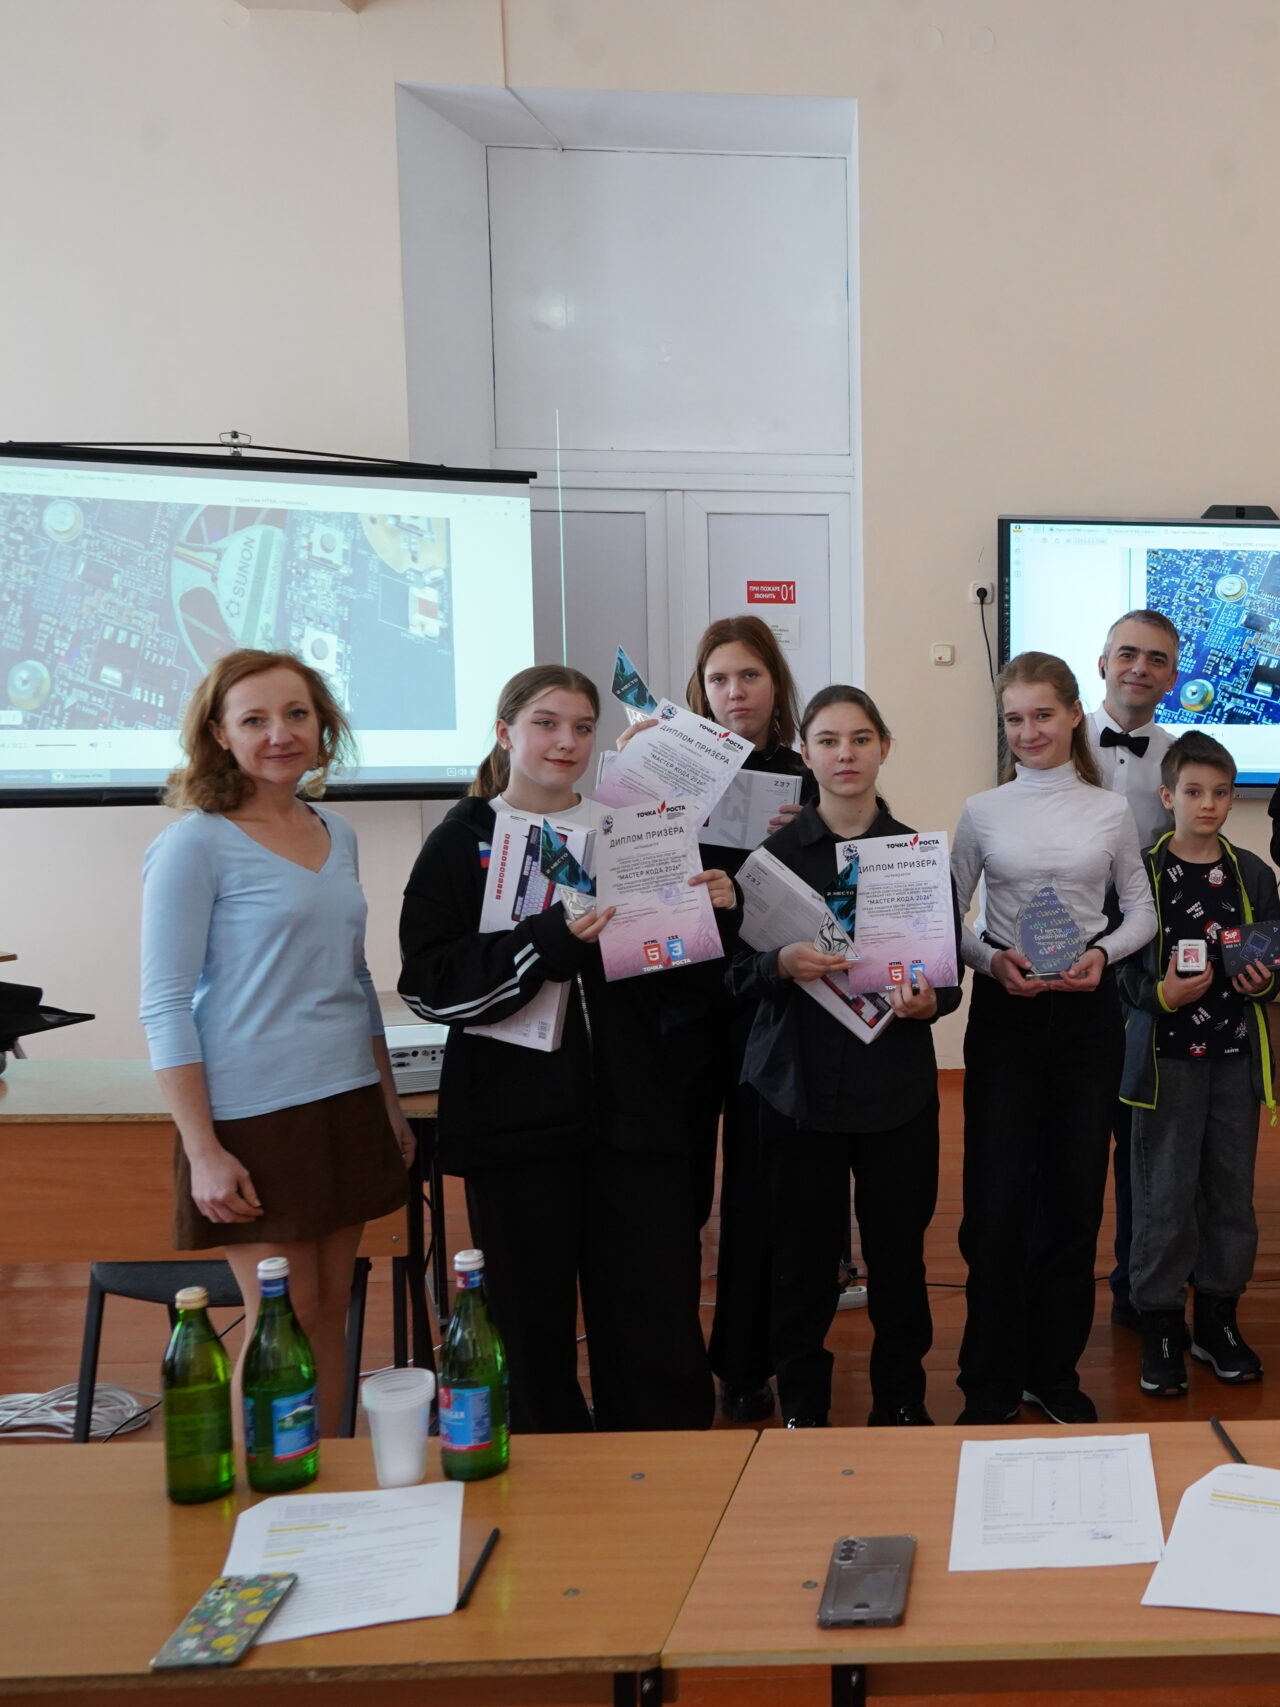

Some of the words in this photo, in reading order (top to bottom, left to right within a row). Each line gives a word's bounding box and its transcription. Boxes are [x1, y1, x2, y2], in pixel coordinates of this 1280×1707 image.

[232, 536, 257, 598] SUNON
[781, 584, 794, 600] 01
[659, 724, 695, 745] ДИПЛОМ
[695, 741, 730, 765] ПРИЗЁРА
[699, 723, 718, 736] ТОЧКА
[725, 737, 744, 751] РОСТА
[636, 810, 657, 819] ТОЧКА
[666, 805, 686, 813] РОСТА
[609, 834, 643, 849] ДИПЛОМ
[645, 826, 685, 840] ПРИЗЁРА
[897, 859, 937, 870] ПРИЗЁРА
[646, 948, 659, 961] 5
[670, 942, 682, 956] 3
[642, 964, 663, 973] ТОЧКА
[671, 958, 692, 967] РОСТА
[891, 968, 902, 981] 5
